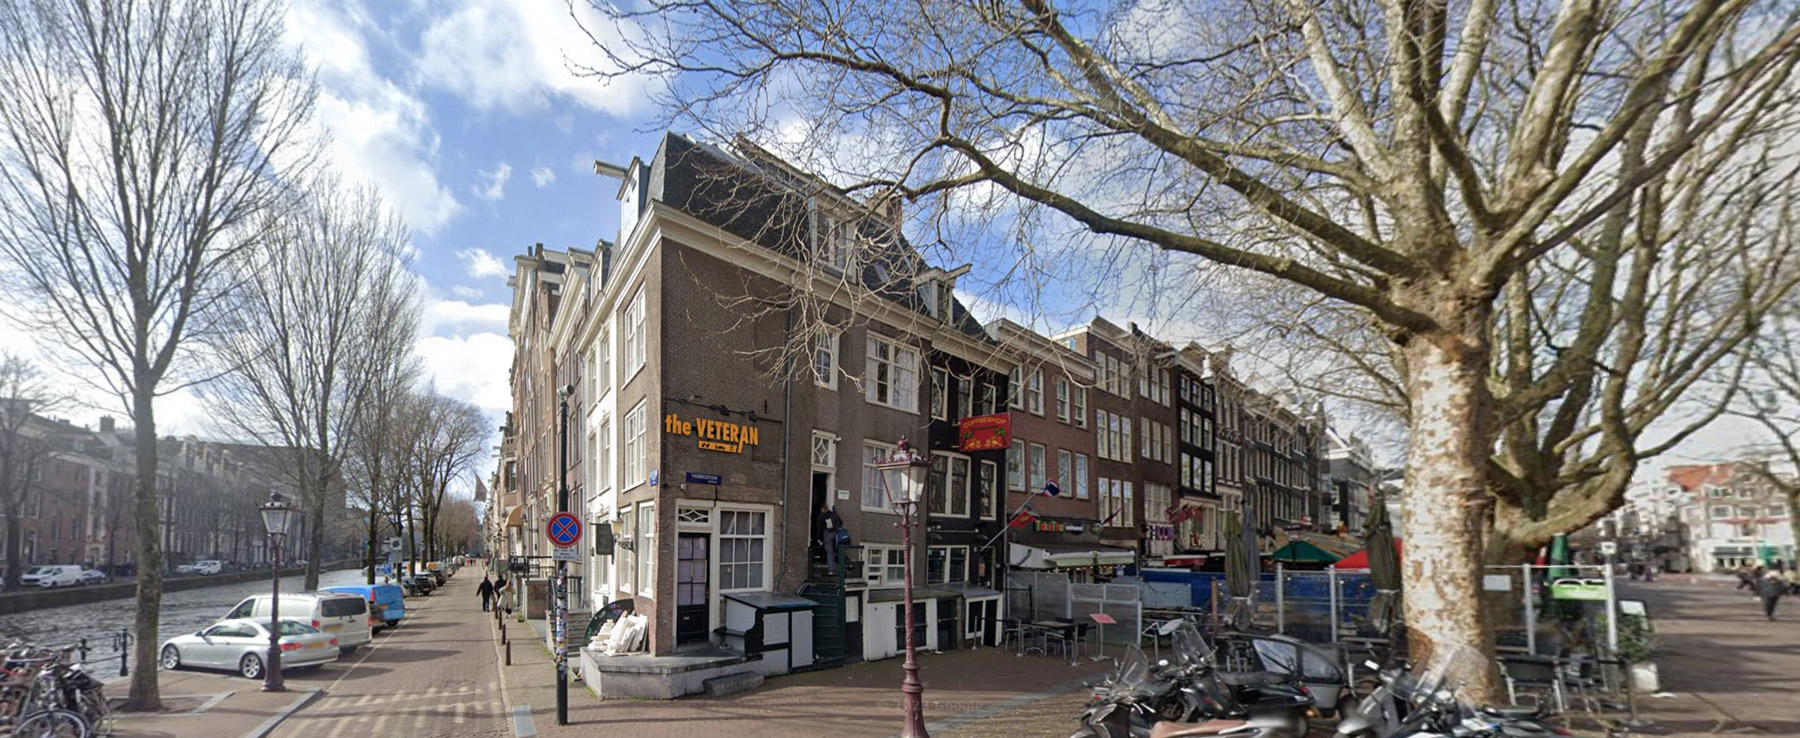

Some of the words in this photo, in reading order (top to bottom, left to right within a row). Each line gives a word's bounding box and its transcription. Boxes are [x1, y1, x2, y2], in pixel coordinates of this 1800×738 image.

[665, 413, 692, 436] the
[696, 417, 759, 454] VETERAN
[963, 416, 1007, 429] COFFEESHOP
